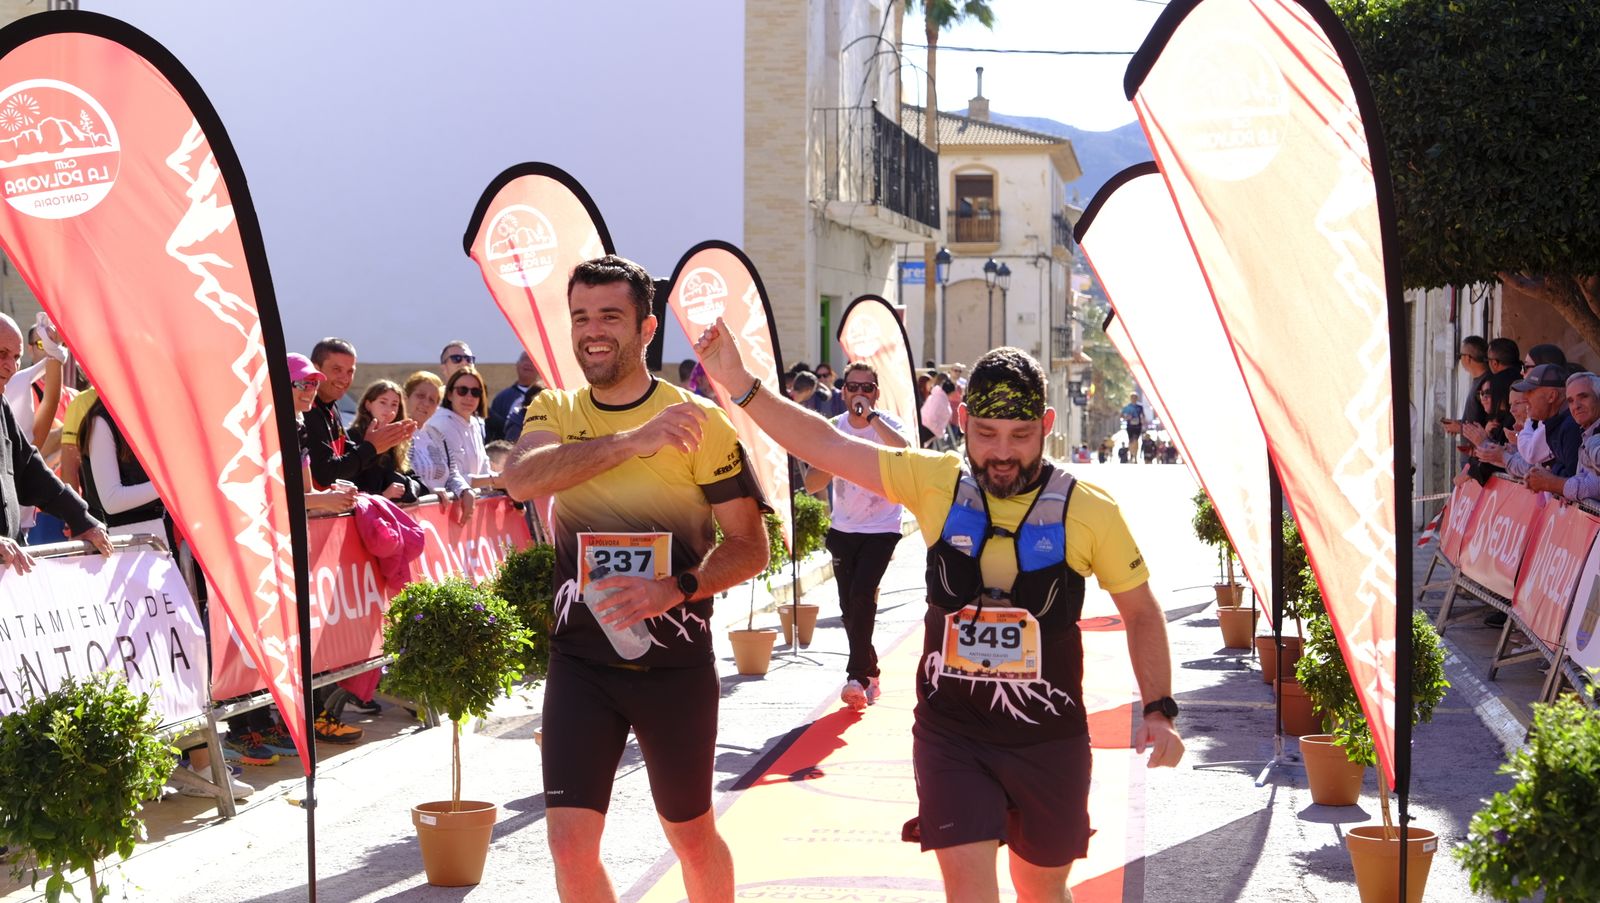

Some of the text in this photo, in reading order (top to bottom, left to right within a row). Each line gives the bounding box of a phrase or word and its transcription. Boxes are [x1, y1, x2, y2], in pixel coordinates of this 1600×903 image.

[594, 550, 652, 572] 237
[144, 593, 176, 618] DE
[309, 561, 386, 628] EOLIA
[959, 624, 1020, 649] 349
